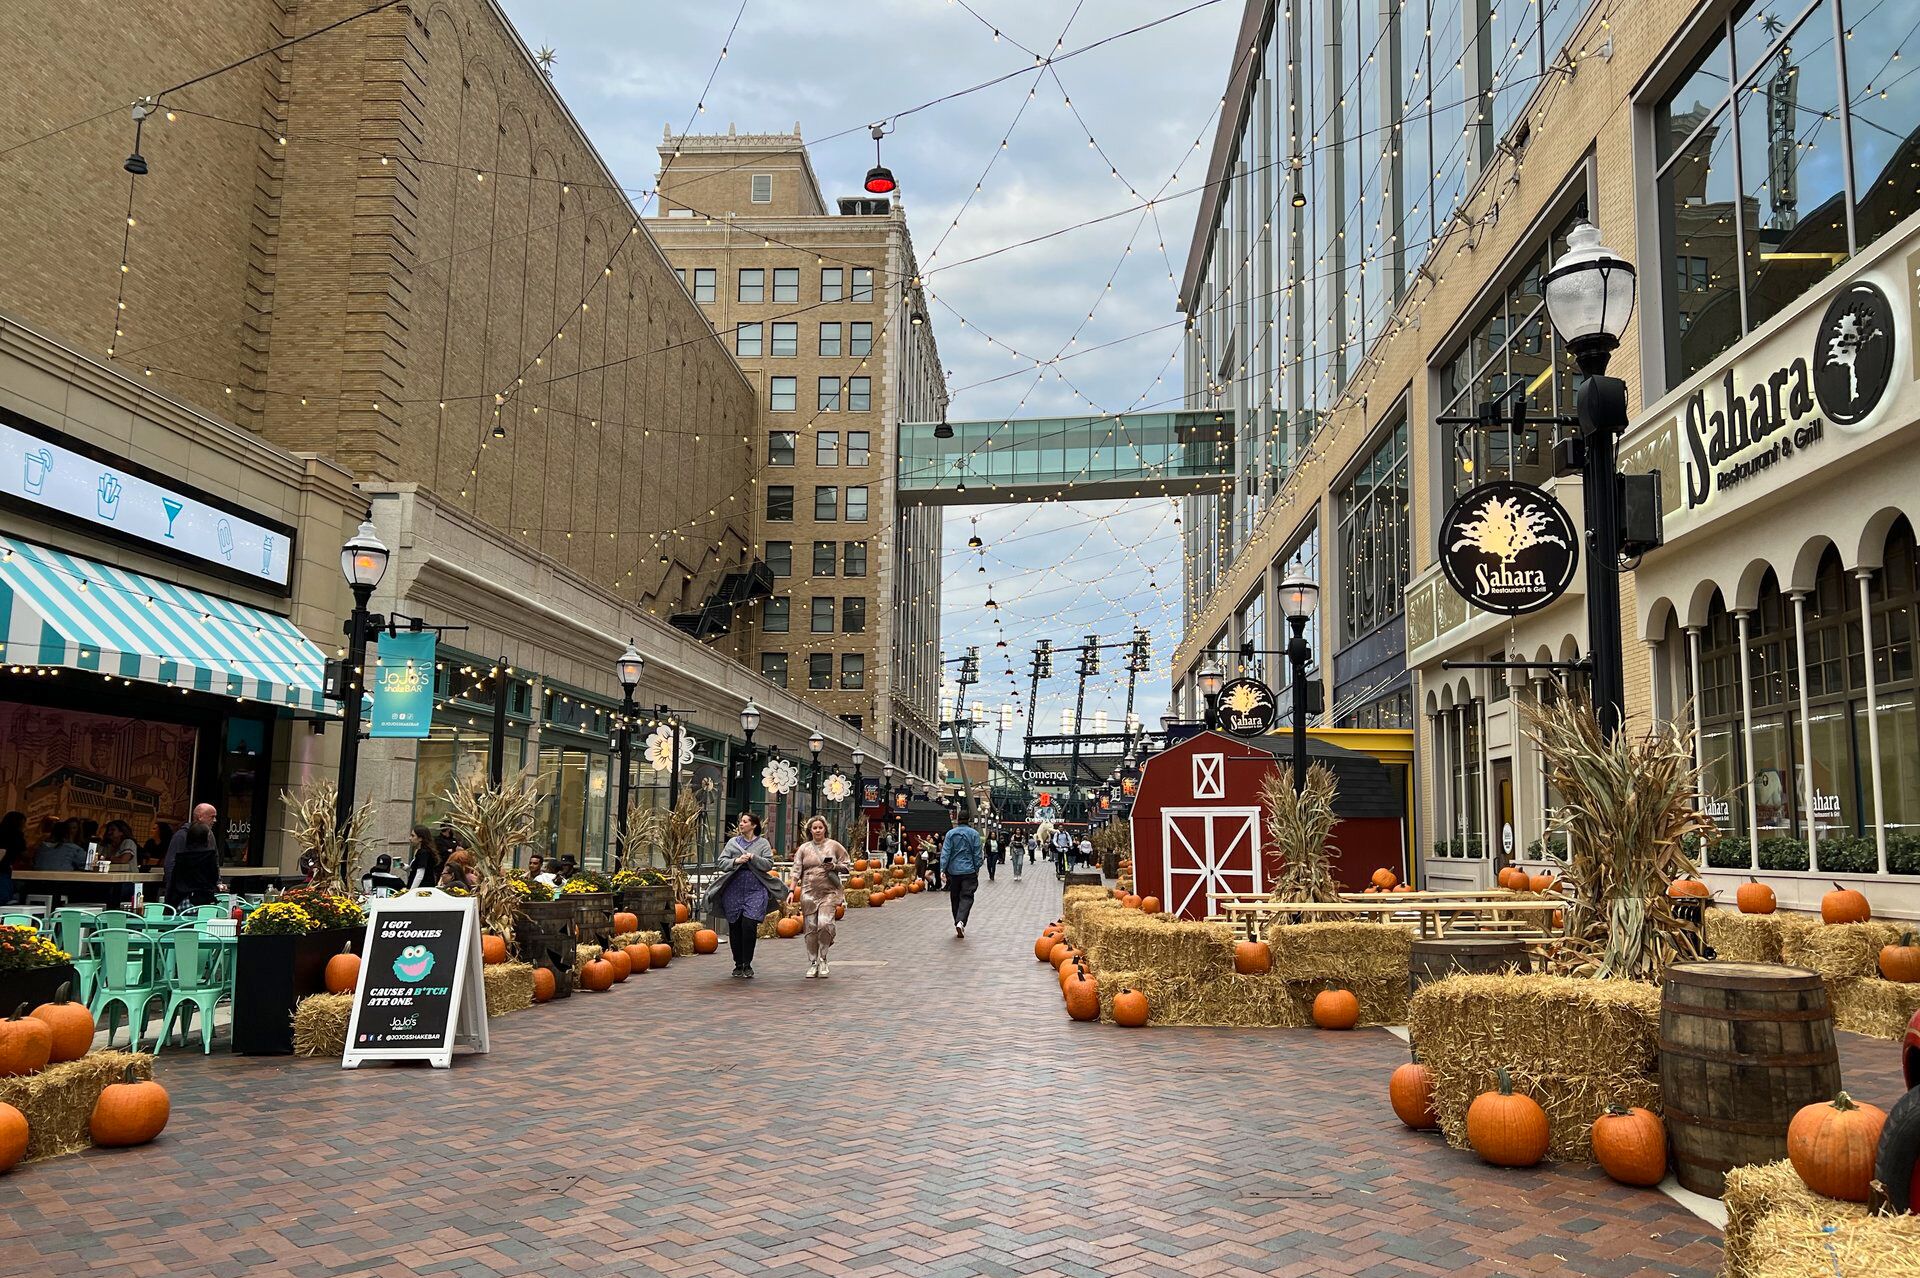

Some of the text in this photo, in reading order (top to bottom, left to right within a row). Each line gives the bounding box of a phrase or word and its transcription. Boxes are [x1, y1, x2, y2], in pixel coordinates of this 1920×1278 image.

[1686, 357, 1814, 510] Sahara
[1717, 418, 1822, 491] Restaurant & Grill
[1475, 563, 1546, 596] Sahara
[378, 668, 430, 685] JoJo's
[1230, 715, 1263, 730] Sahara
[1813, 788, 1840, 811] ahara
[382, 921, 412, 929] I GOT
[381, 929, 443, 938] 99 COOKIES
[370, 988, 405, 996] CAUSE
[404, 987, 414, 996] A
[367, 997, 413, 1006] ATE ONE.
[389, 1017, 417, 1026] JoJo's
